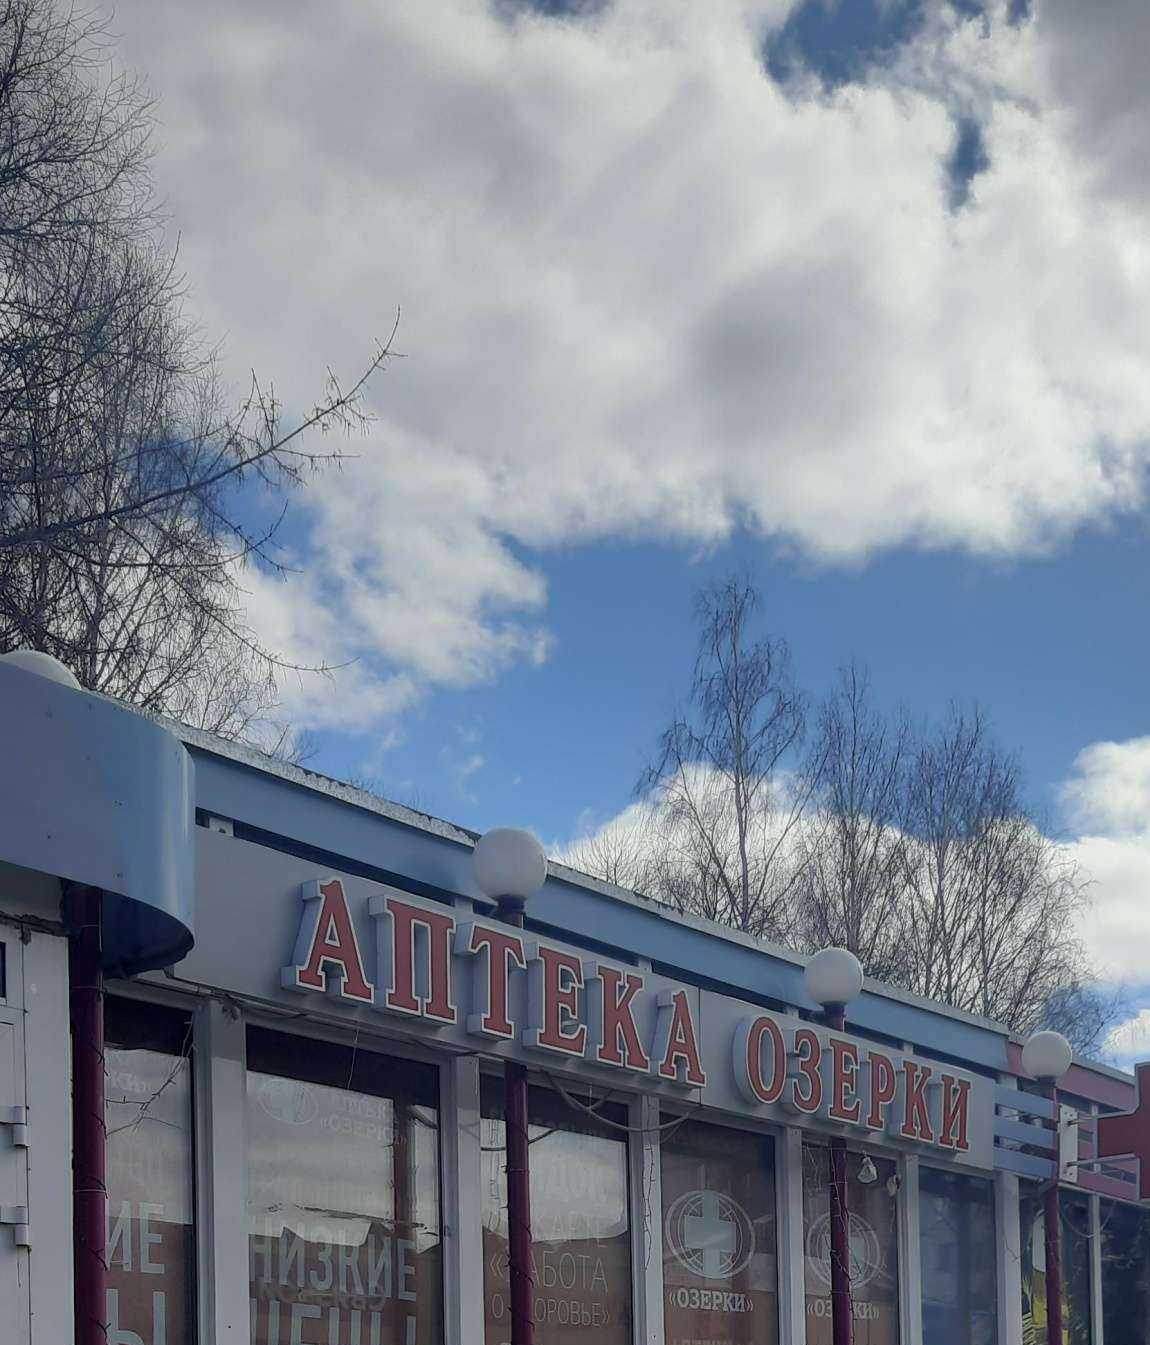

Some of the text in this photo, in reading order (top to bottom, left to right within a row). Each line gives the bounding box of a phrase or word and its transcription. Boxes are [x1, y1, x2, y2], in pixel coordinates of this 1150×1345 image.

[290, 877, 971, 1152] АПТЕКА ОЗЕРКИ
[105, 1200, 165, 1275] ИЕ
[248, 1215, 418, 1302] НИЗКИЕ
[489, 1249, 609, 1294] «АБОТА
[530, 1298, 610, 1327] ОРОВЬЕ»
[669, 1287, 754, 1313] «ОЗЕРКИ»
[807, 1299, 880, 1320] «ОЗКИ»
